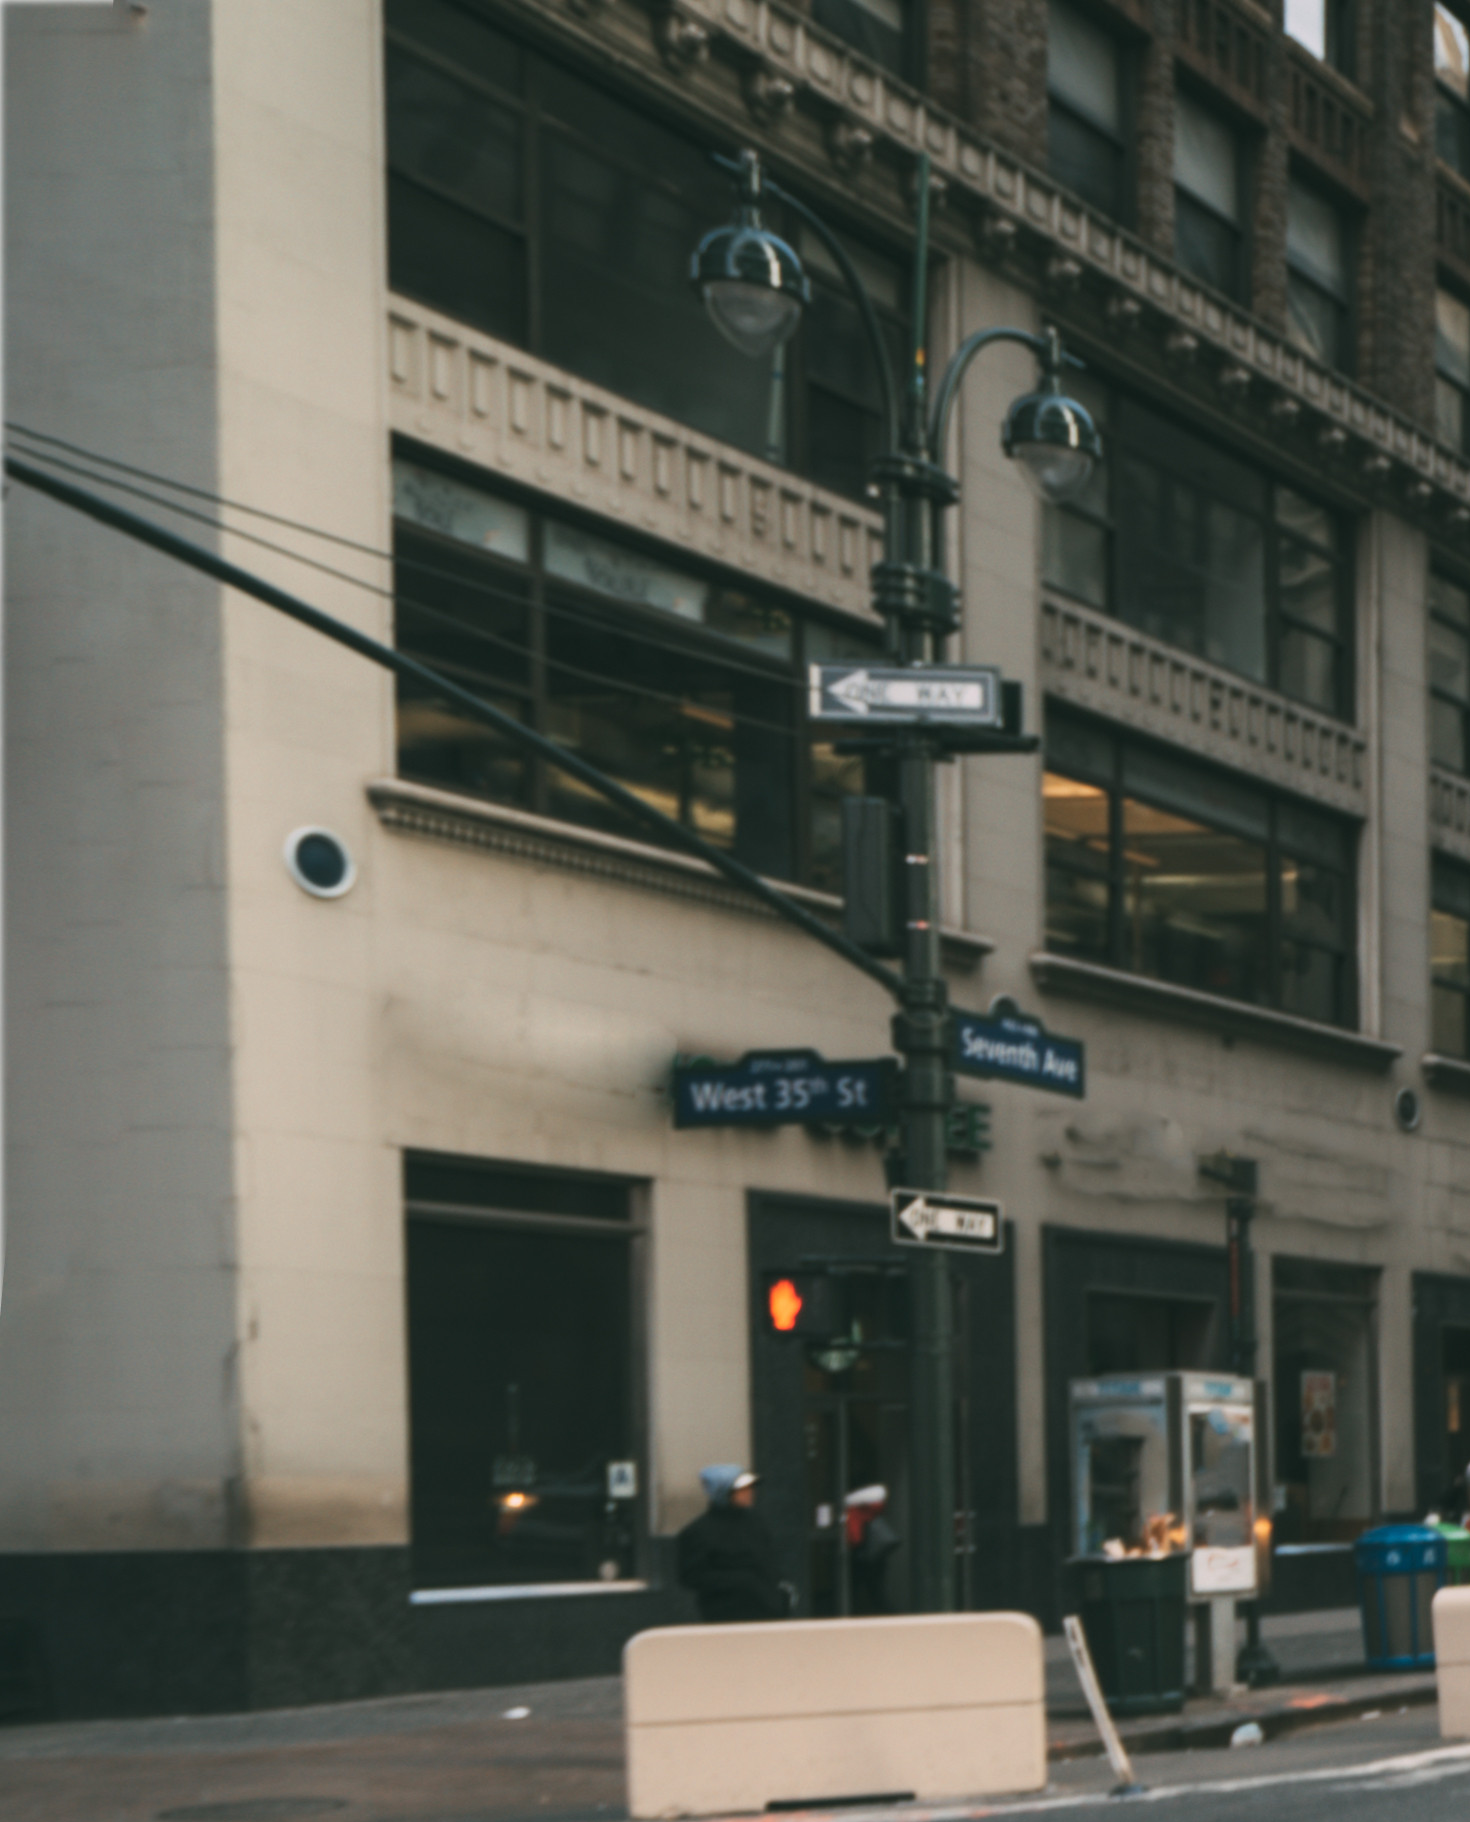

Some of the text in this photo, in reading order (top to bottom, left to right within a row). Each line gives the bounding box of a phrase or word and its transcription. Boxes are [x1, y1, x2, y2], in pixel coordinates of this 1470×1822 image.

[844, 680, 965, 706] ONE WAY
[961, 1026, 1038, 1073] Seventh
[1042, 1048, 1078, 1083] Ave
[689, 1077, 869, 1112] West 35th St
[910, 1208, 988, 1234] ONE WAY
